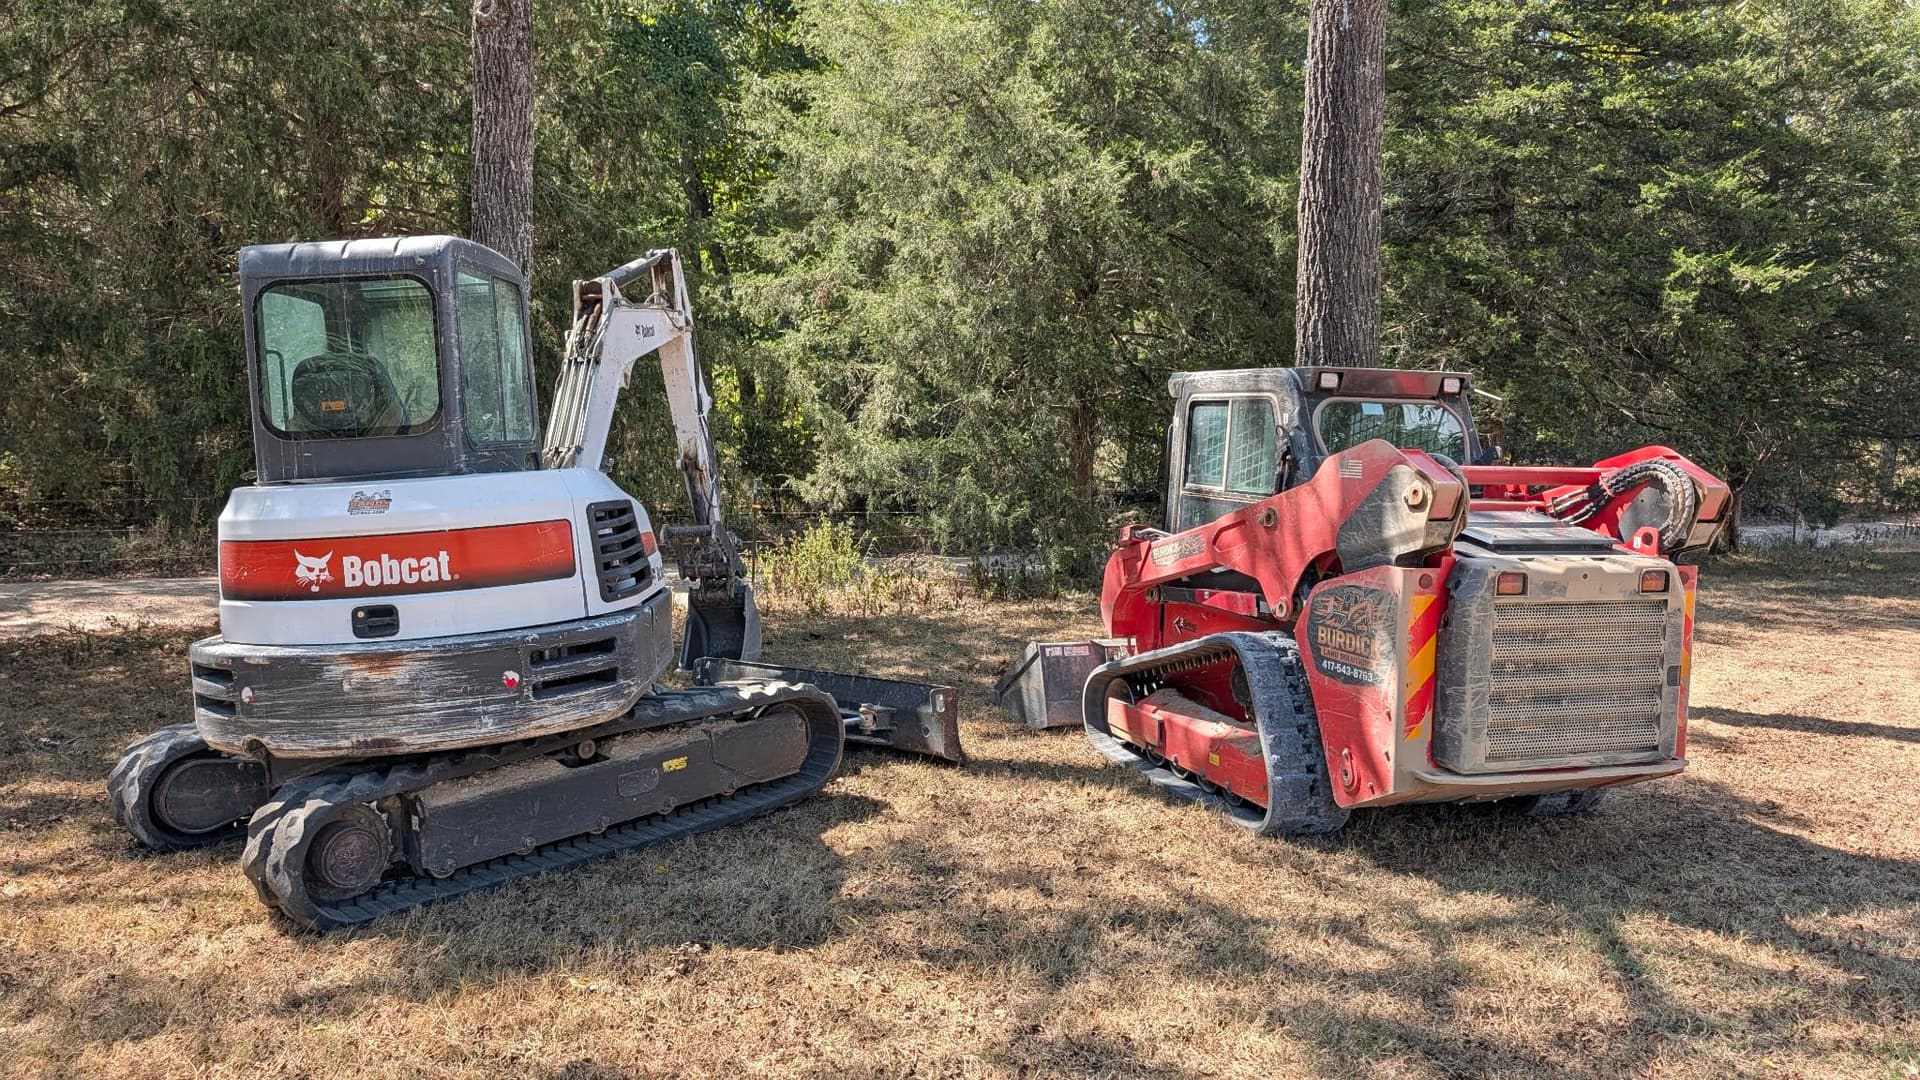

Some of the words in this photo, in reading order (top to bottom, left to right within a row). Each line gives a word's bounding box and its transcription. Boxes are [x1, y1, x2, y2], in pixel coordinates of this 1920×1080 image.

[342, 550, 452, 588] Bobcat
[1316, 625, 1379, 660] BURDICK
[1321, 660, 1374, 682] 417-543-8763
